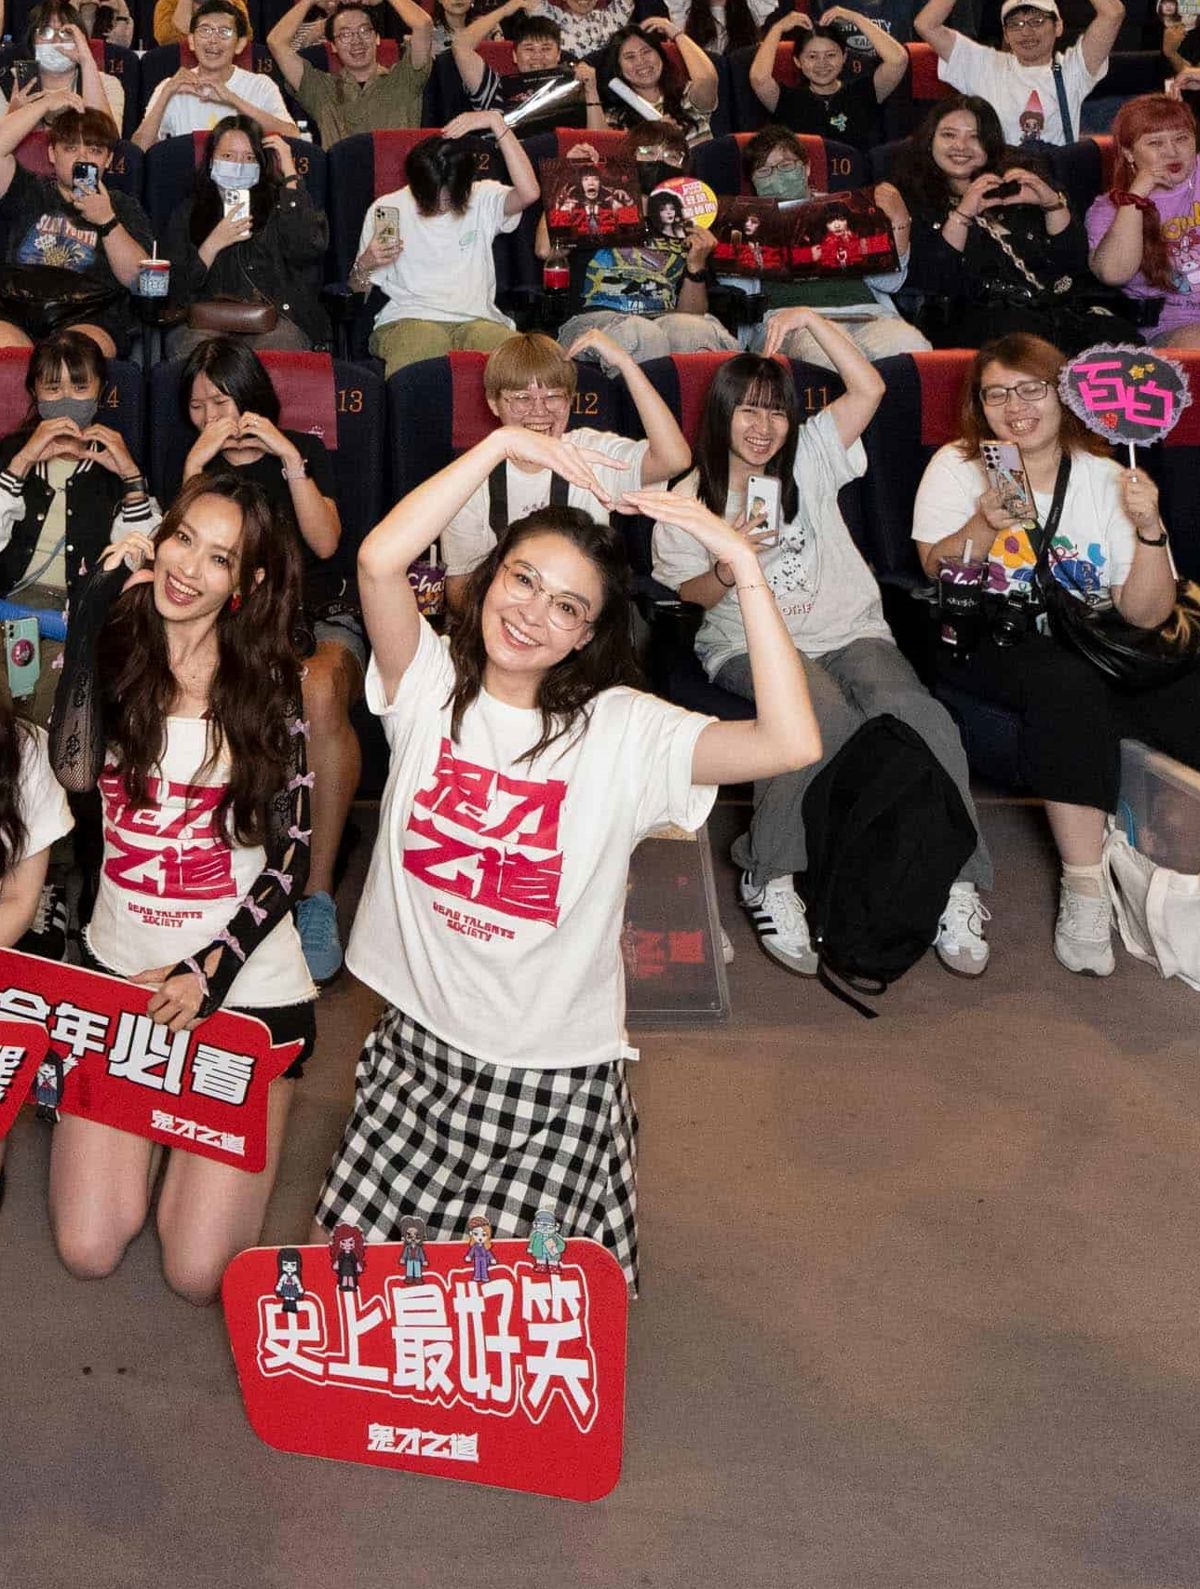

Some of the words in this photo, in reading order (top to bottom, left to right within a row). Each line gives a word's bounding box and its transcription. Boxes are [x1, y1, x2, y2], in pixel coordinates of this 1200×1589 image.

[109, 59, 125, 73] 14
[830, 153, 851, 170] 10
[336, 389, 363, 413] 13
[572, 391, 599, 415] 12
[803, 386, 830, 410] 11
[407, 572, 446, 593] Cha
[142, 914, 184, 928] SOCIETY
[154, 910, 204, 919] TALENTS
[432, 901, 461, 921] DEAD
[462, 914, 516, 940] TALENTS
[446, 919, 492, 943] SOCIETY
[151, 1108, 246, 1157] 鬼才之道
[264, 1274, 593, 1417] 史上最好笑
[367, 1422, 479, 1464] 鬼才之道
